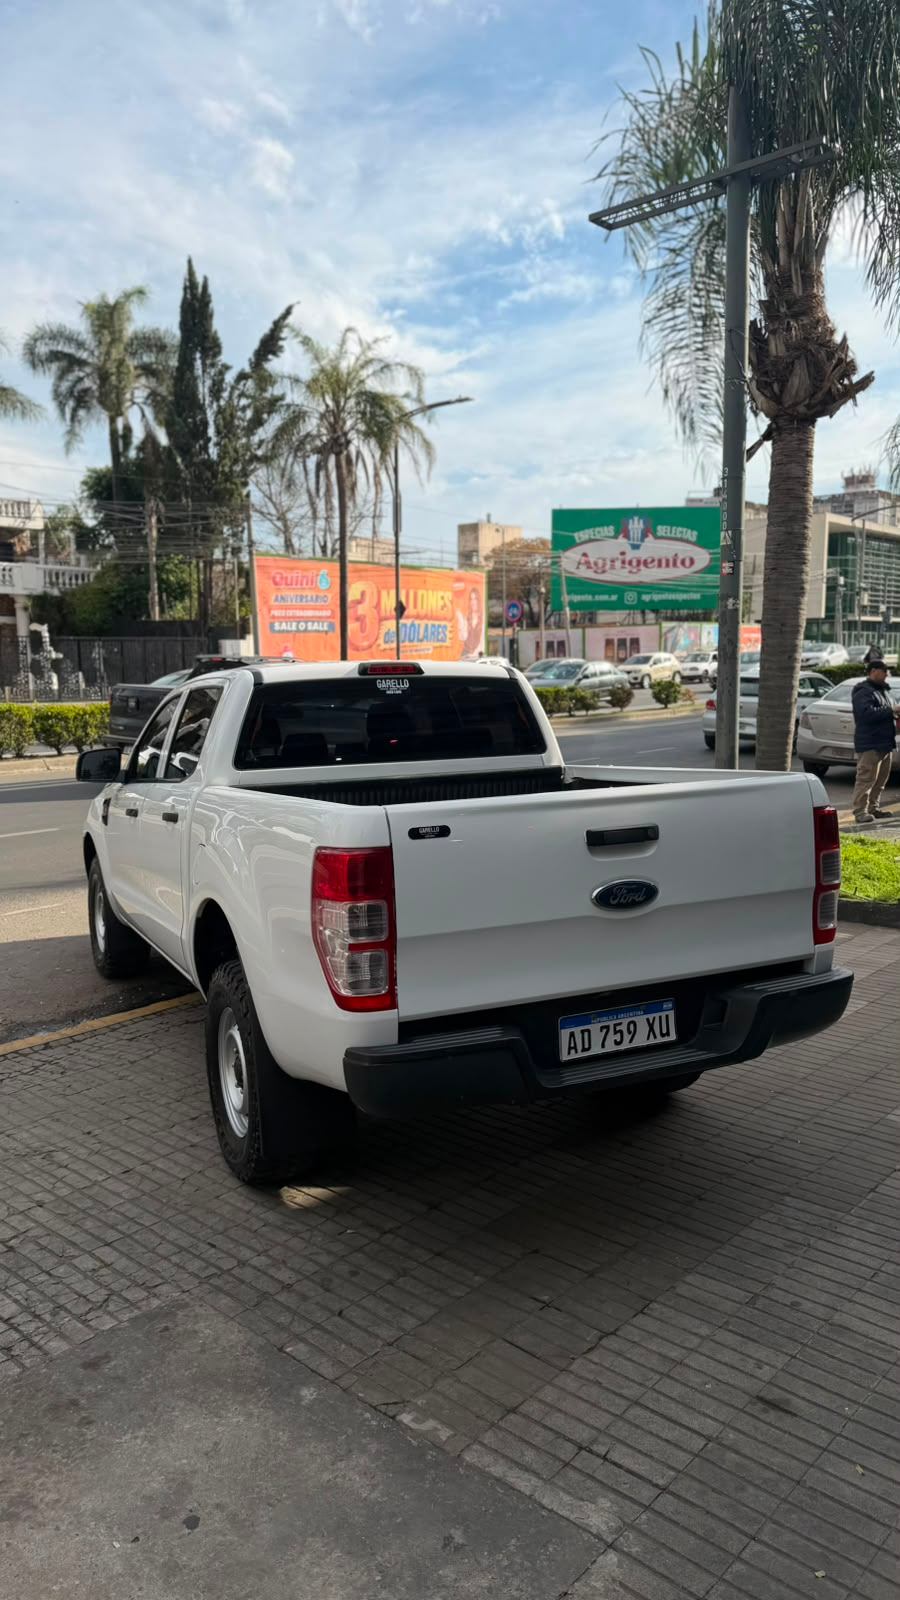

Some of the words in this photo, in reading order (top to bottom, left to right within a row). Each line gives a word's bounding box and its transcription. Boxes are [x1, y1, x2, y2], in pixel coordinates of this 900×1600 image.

[574, 526, 614, 543] ESPECIAS
[656, 525, 698, 542] SELECTAS
[576, 551, 695, 574] Agrigento
[271, 571, 315, 588] Quini
[273, 594, 329, 604] ANIVERSARIO
[349, 580, 380, 651] 3
[381, 589, 452, 618] MLLONES
[274, 622, 297, 631] SALE
[298, 622, 306, 631] O
[307, 622, 329, 631] SALE
[399, 621, 448, 643] DÓLARES
[376, 679, 409, 689] GARELLO
[609, 886, 647, 905] Ford
[567, 1028, 592, 1056] AD
[600, 1020, 638, 1049] 759
[646, 1014, 670, 1041] XU
